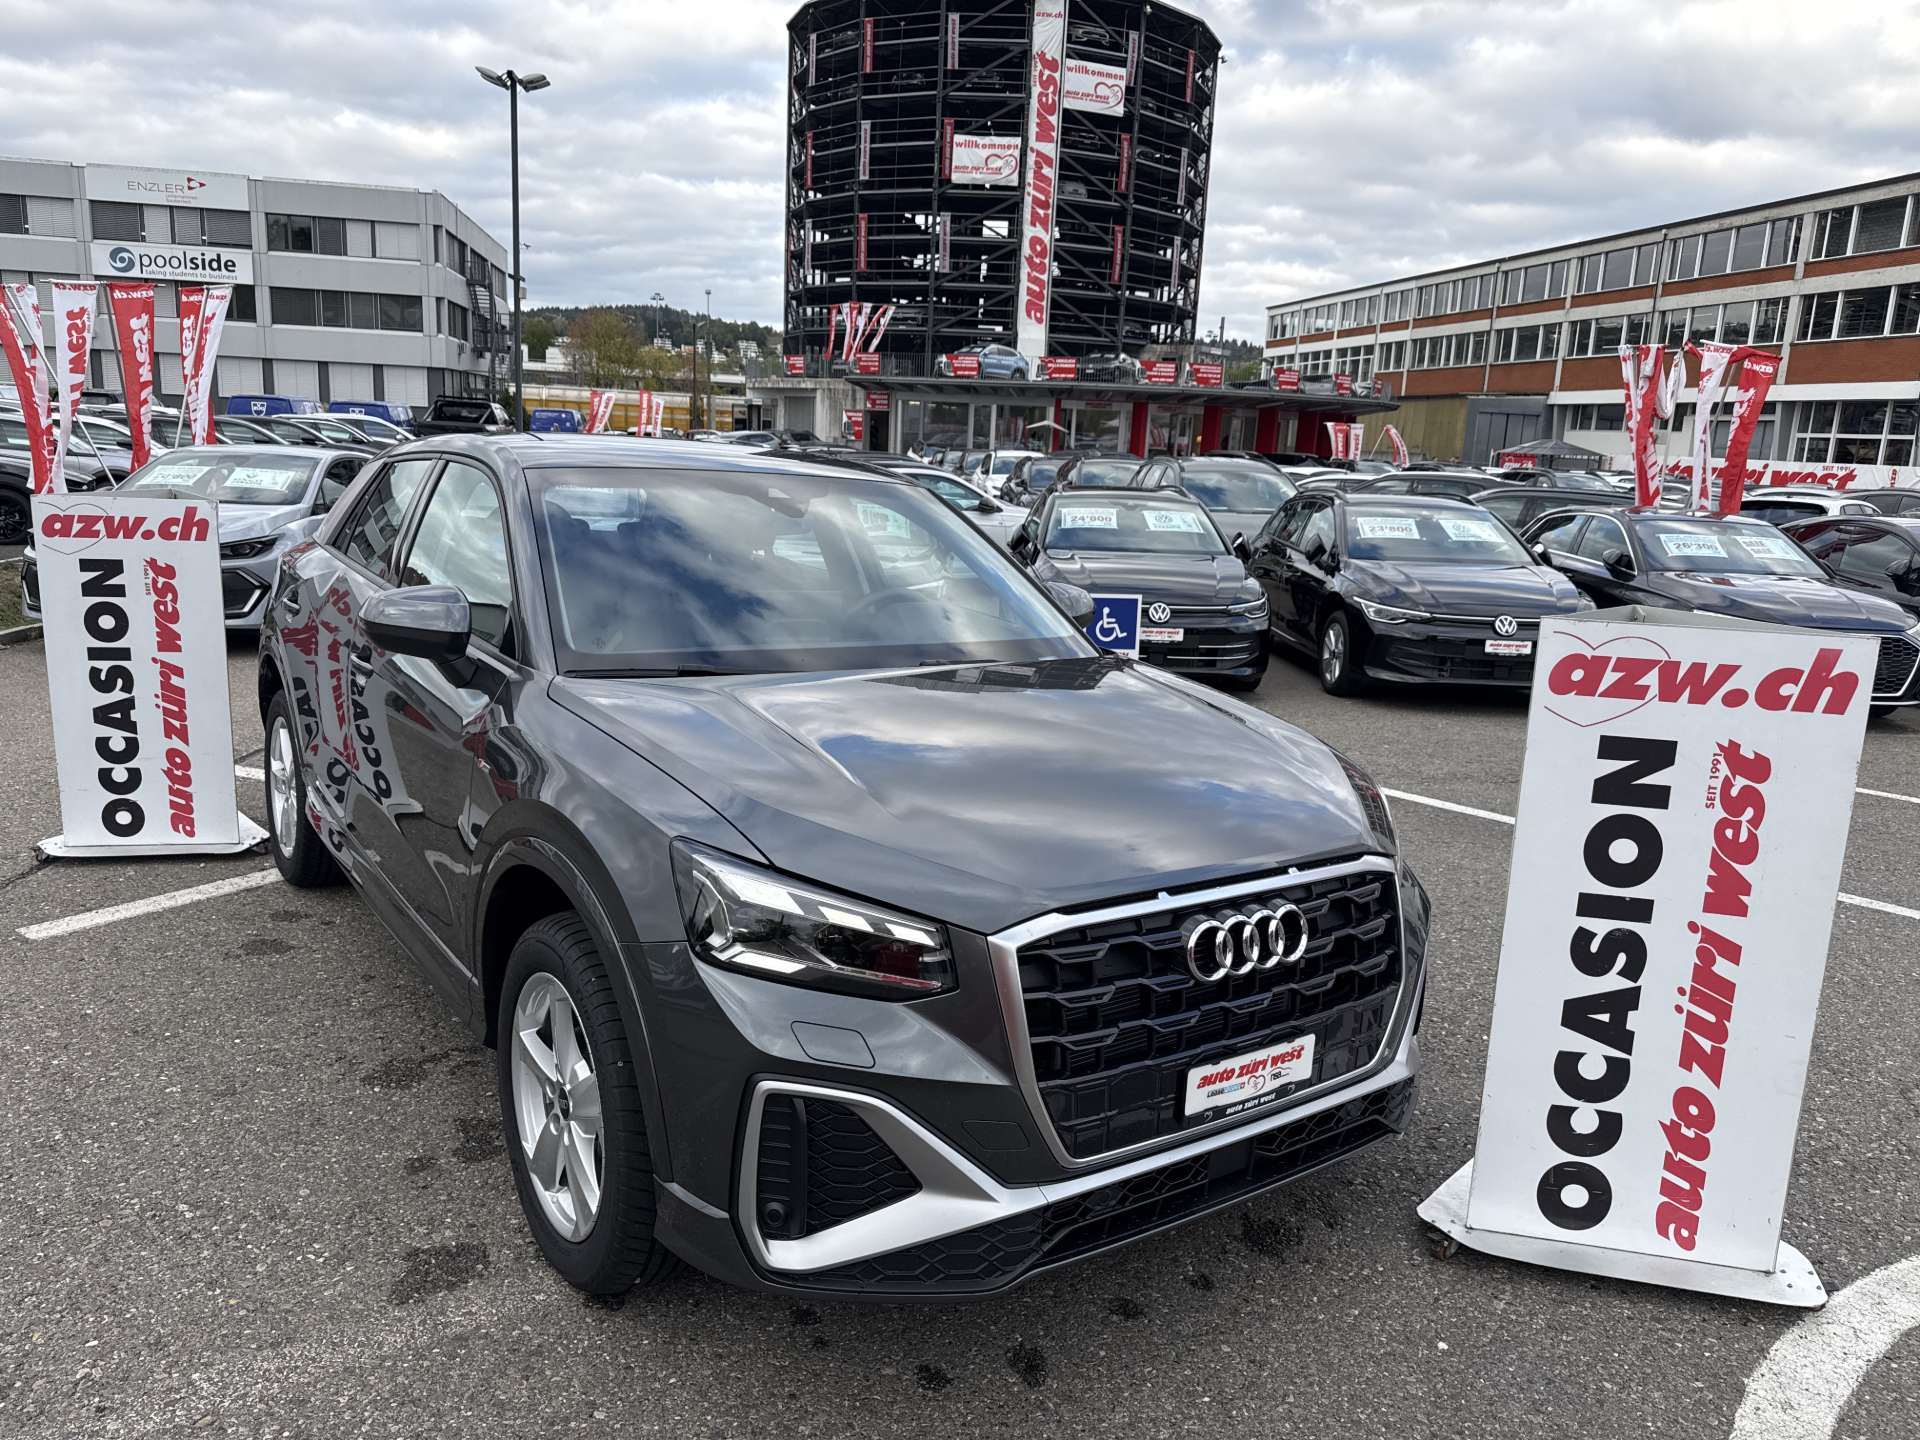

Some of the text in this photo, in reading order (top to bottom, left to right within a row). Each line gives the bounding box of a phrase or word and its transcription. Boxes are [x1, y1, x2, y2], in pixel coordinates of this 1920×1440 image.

[1066, 65, 1125, 81] willkommen
[955, 140, 1019, 150] willkommen
[127, 180, 185, 194] ENZLER
[1024, 50, 1060, 325] auto züri west
[139, 251, 237, 274] poolside
[145, 269, 167, 278] taking
[168, 270, 198, 279] students
[208, 272, 238, 281] business
[1770, 467, 1857, 490] west
[41, 506, 210, 542] azw.ch
[78, 558, 145, 838] OCCASION
[149, 556, 196, 838] auto züri west
[1547, 648, 1860, 716] azw.ch
[1704, 752, 1724, 810] SEIT 1991
[1536, 734, 1678, 1230] OCCASION
[1656, 739, 1772, 1252] auto züri west
[1196, 1044, 1305, 1089] auto züri west
[1225, 1105, 1243, 1115] auto
[1259, 1092, 1276, 1104] west
